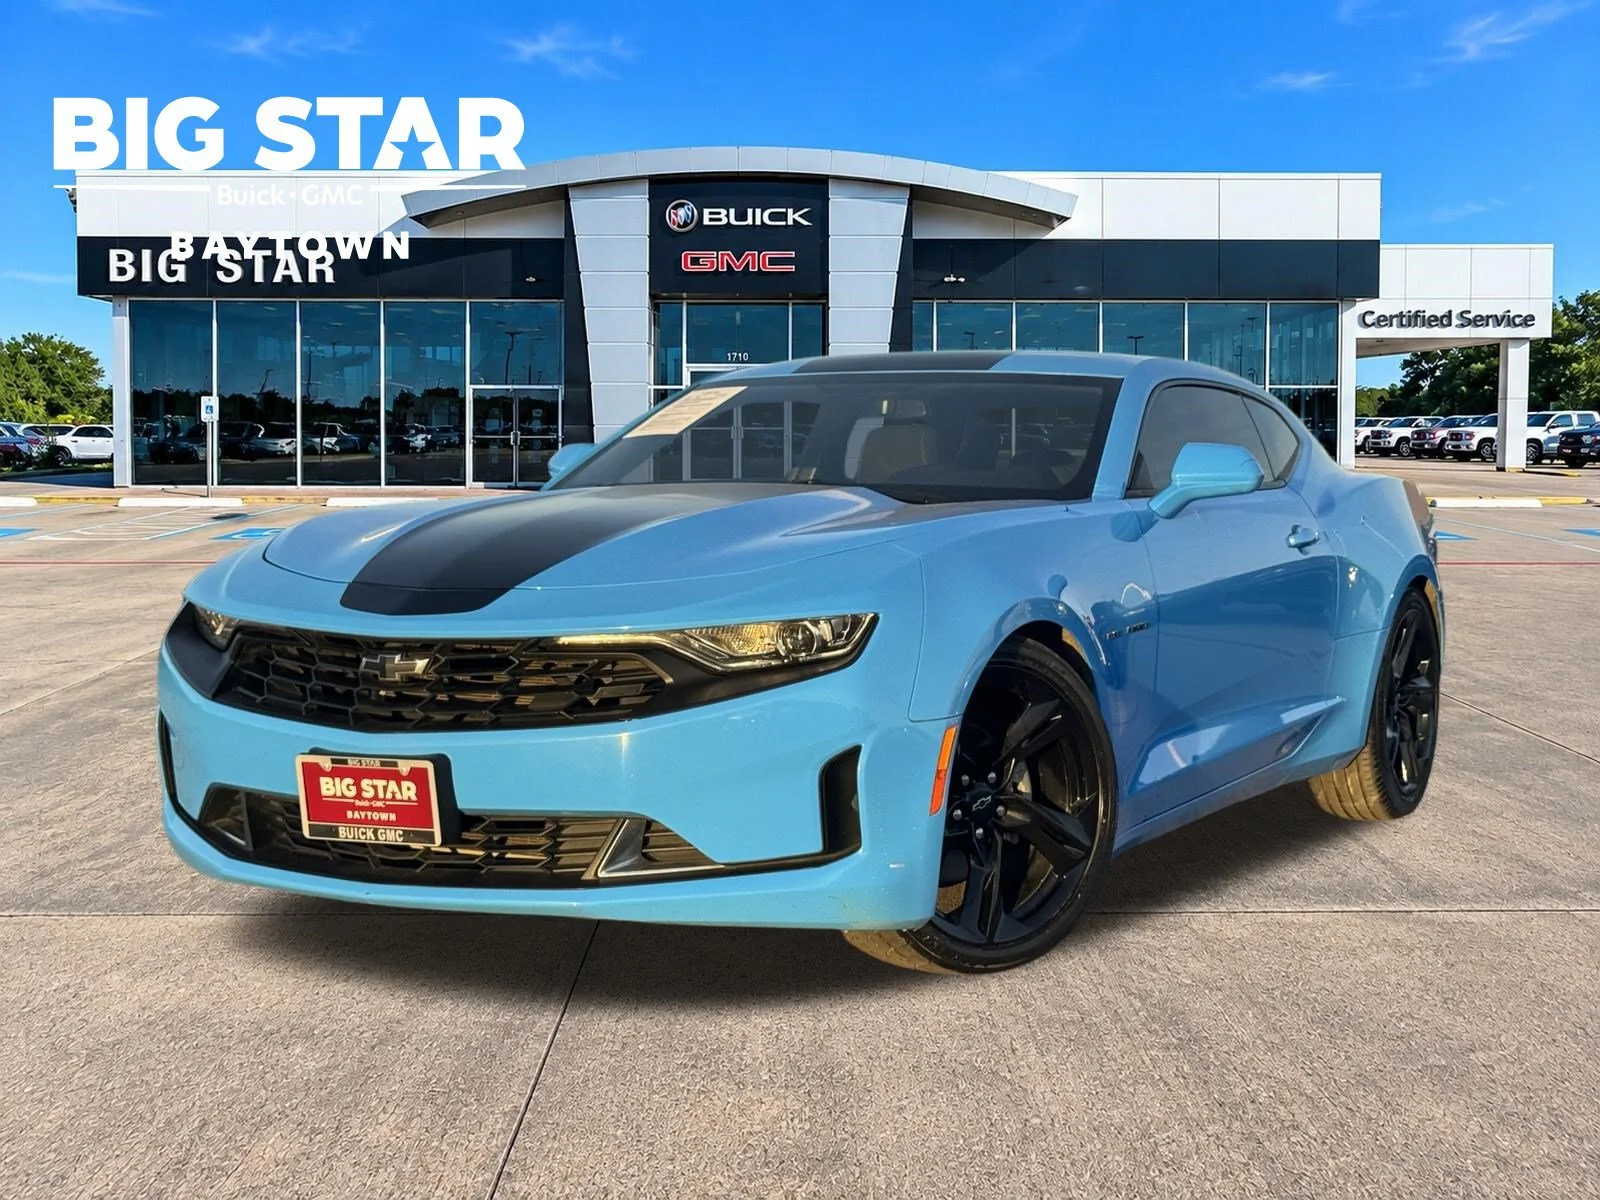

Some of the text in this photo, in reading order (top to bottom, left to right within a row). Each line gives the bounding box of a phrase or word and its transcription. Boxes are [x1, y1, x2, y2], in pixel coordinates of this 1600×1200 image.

[703, 207, 813, 226] BUICK
[108, 247, 336, 284] BIG STAR
[681, 250, 796, 272] GMC
[1359, 309, 1536, 329] Certified Service
[727, 352, 749, 361] 1710
[319, 776, 418, 801] BIG STAR
[346, 810, 397, 822] BAYTOWN
[338, 826, 404, 842] BUICK GMC
